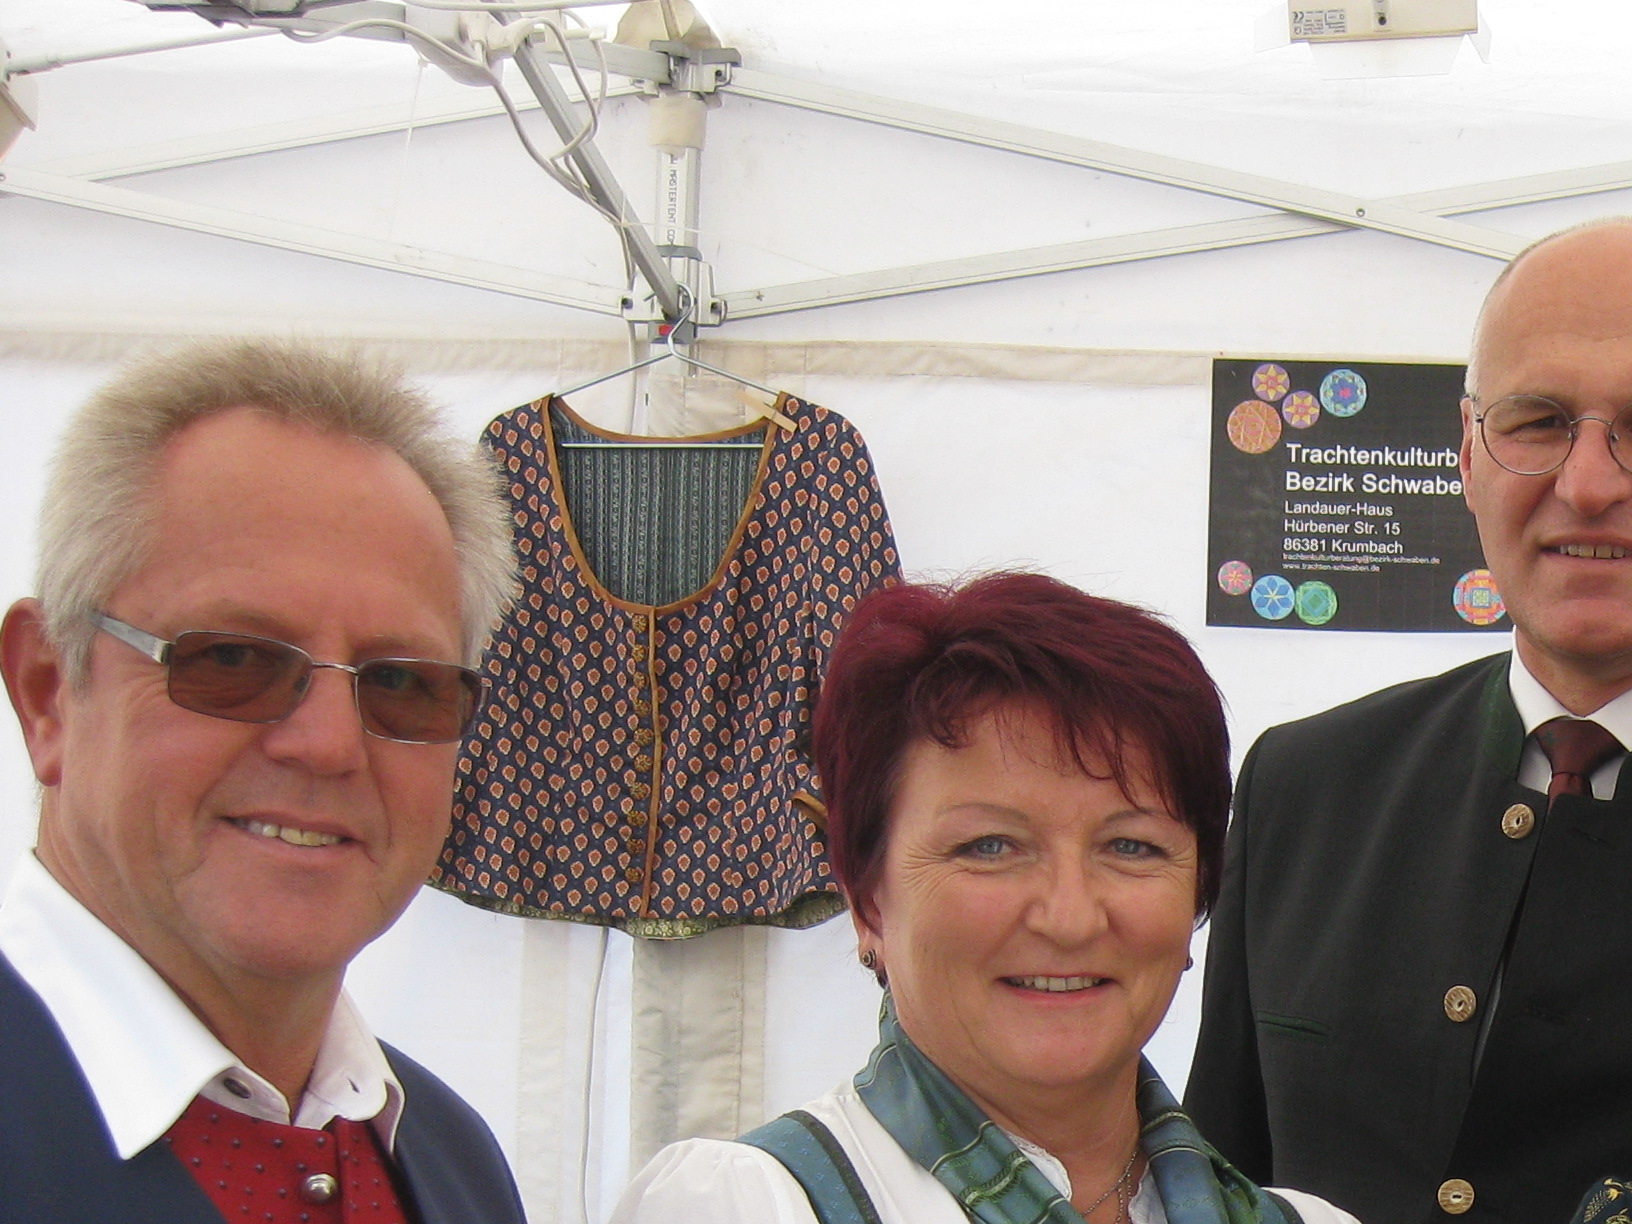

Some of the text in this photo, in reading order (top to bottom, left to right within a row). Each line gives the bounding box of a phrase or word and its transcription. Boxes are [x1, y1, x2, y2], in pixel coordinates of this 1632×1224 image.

[1286, 443, 1459, 468] Trachtenkulturb
[1285, 471, 1462, 495] Bezirk Schwabe
[1284, 500, 1394, 517] Landauer-Haus
[1284, 519, 1401, 536] Hürbener Str. 15
[1283, 537, 1404, 554] 86381 Krumbach
